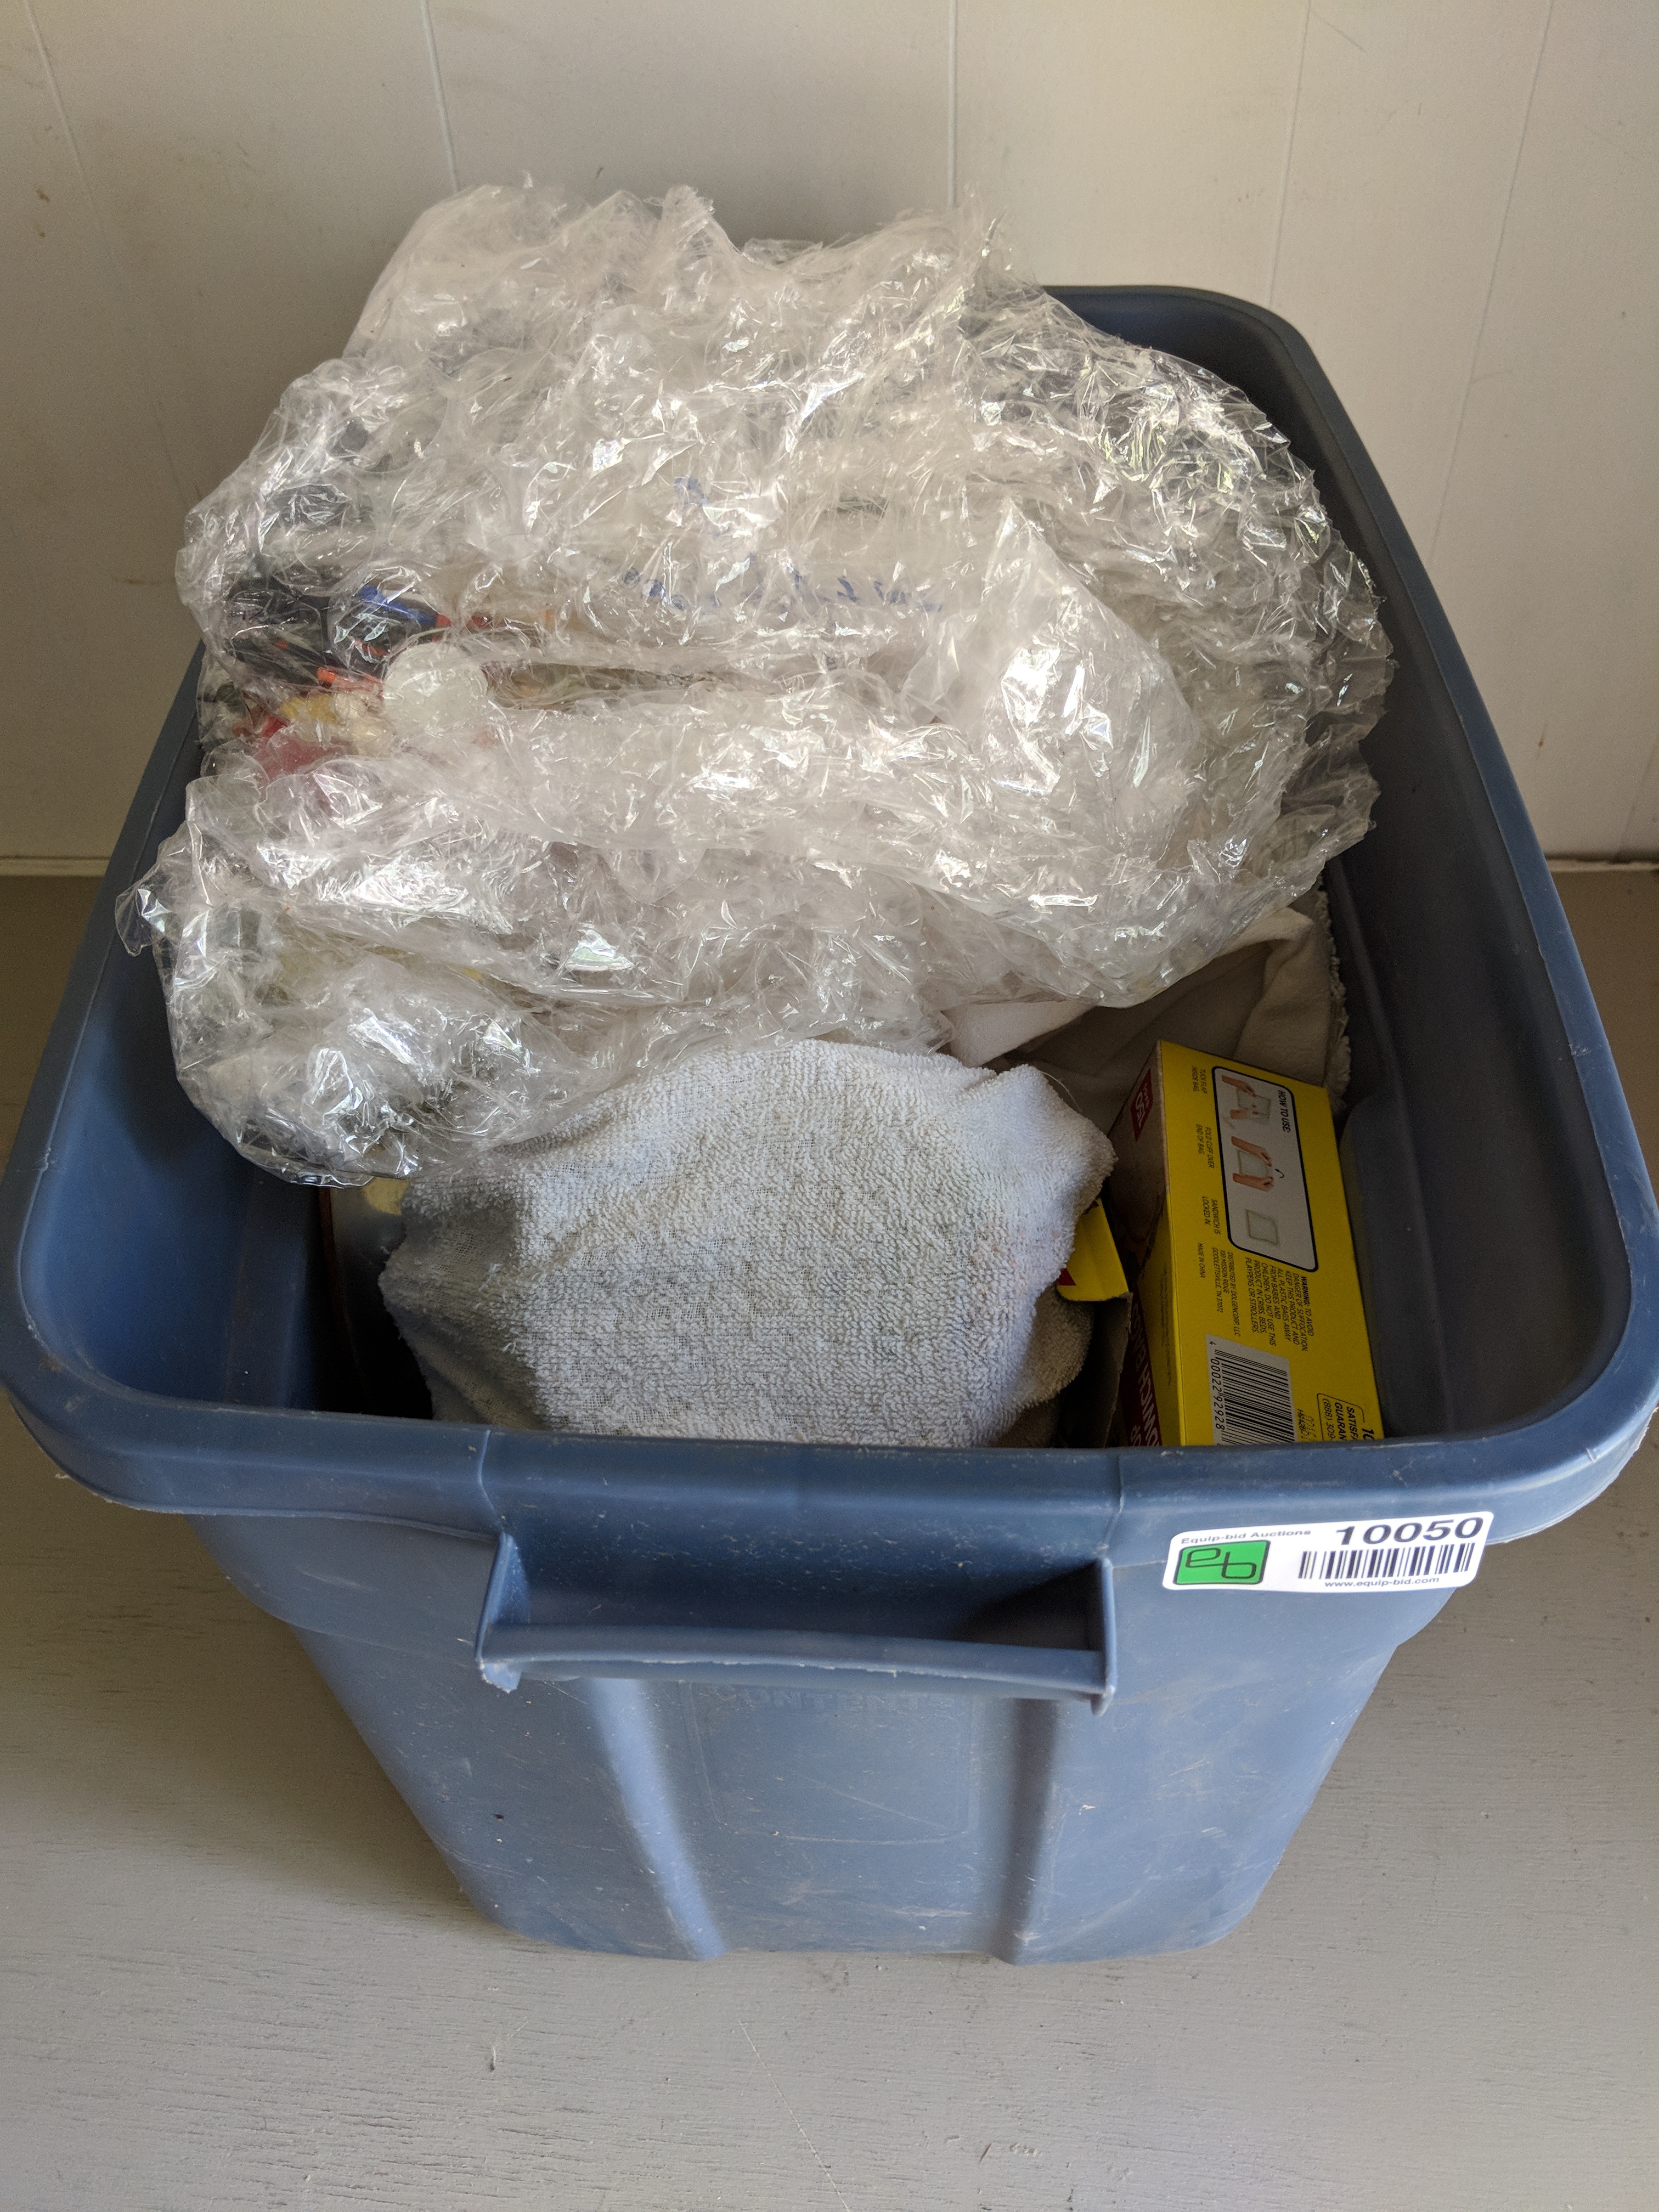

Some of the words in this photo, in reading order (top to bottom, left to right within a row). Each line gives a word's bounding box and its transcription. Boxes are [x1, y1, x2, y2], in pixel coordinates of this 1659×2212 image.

[1278, 1091, 1286, 1107] HOW
[1280, 1108, 1289, 1117] TO
[1282, 1118, 1290, 1133] USE:
[1202, 1197, 1210, 1218] LOCKED
[1211, 1199, 1220, 1228] SANDWICH
[1245, 1257, 1254, 1286] PLAYPENS
[1254, 1260, 1262, 1288] PRODUCT
[1248, 1288, 1255, 1297] OR
[1271, 1283, 1279, 1304] BABIES
[1279, 1280, 1287, 1304] PLASTIC
[1293, 1273, 1301, 1297] DANGER
[1301, 1277, 1310, 1306] WARNING:
[1265, 1294, 1272, 1304] DO
[1296, 1299, 1303, 1308] OF
[1281, 1305, 1289, 1322] BAGS
[1289, 1301, 1298, 1330] PRODUCT
[1139, 1362, 1160, 1446] DWICH
[1322, 1398, 1333, 1420] (888)
[1181, 1533, 1246, 1544] Equip-bid
[1250, 1530, 1311, 1538] Auctions
[1335, 1517, 1484, 1546] 10050
[1185, 1547, 1257, 1579] eb
[1324, 1577, 1440, 1588] www.equip-bid.com
